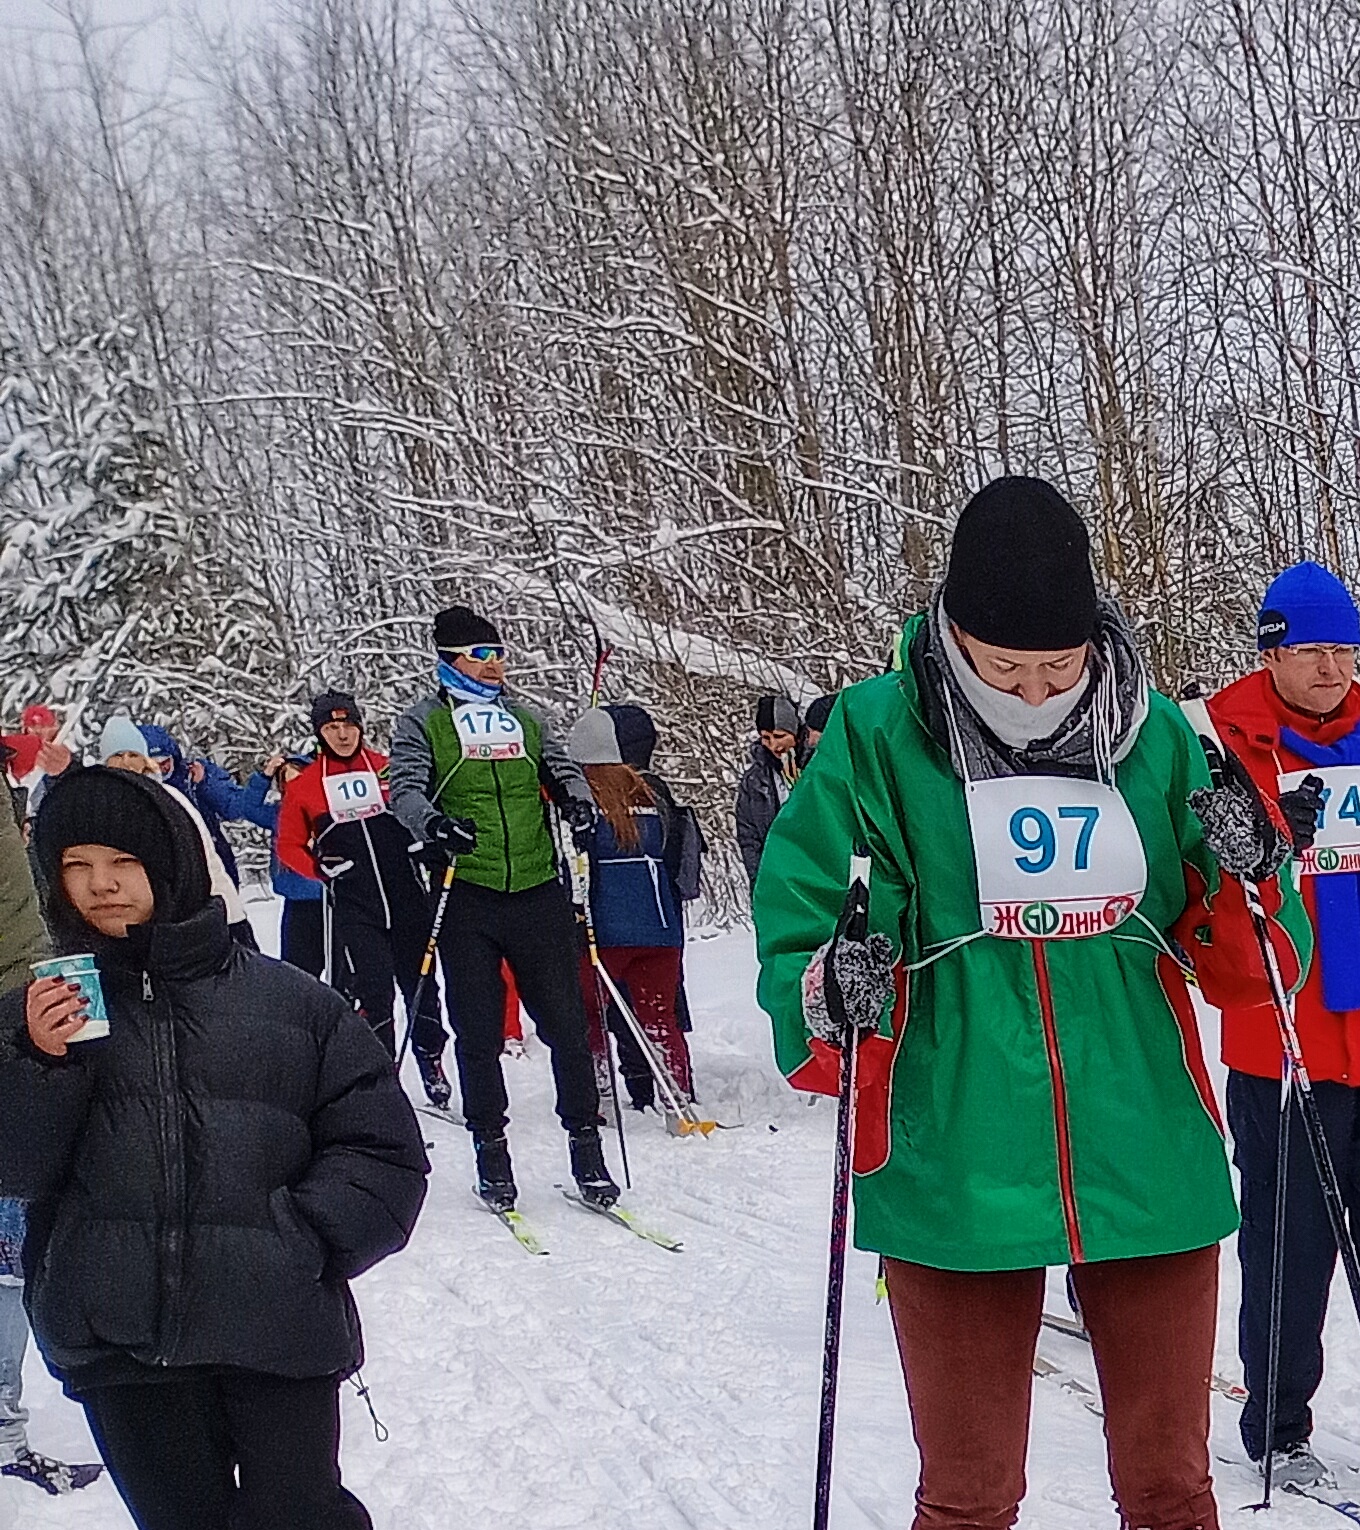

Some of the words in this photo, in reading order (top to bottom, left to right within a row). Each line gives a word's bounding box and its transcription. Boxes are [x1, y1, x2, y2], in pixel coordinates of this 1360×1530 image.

[458, 710, 518, 735] 175
[336, 778, 368, 801] 10
[1008, 805, 1101, 874] 97
